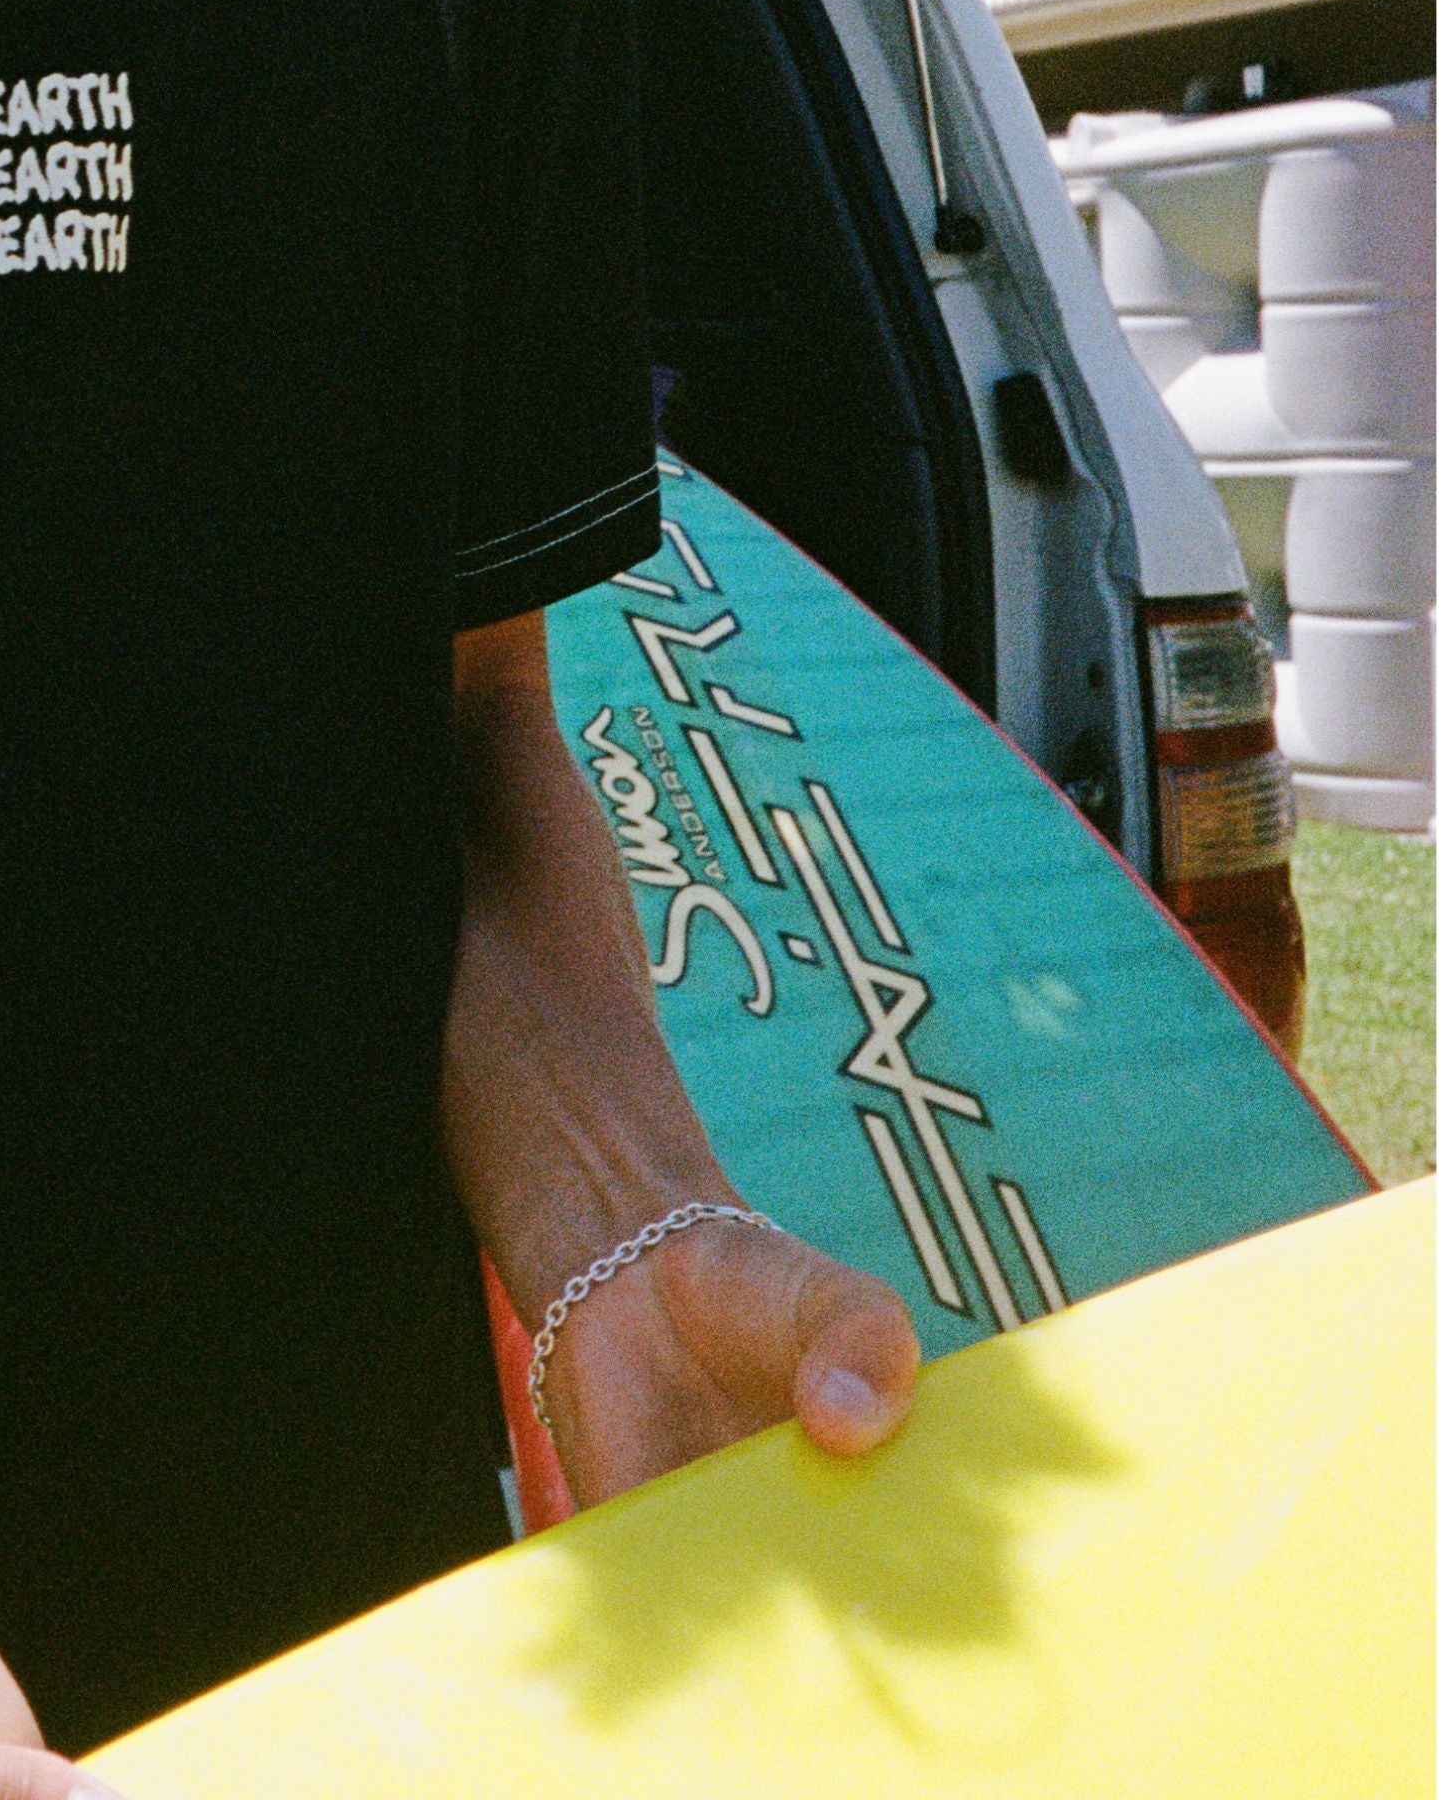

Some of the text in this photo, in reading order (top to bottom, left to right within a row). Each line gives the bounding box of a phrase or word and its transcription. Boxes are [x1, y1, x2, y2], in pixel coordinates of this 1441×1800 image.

[581, 703, 775, 1018] Simon
[609, 460, 1069, 1332] ENER
[630, 704, 727, 883] ANDERSON
